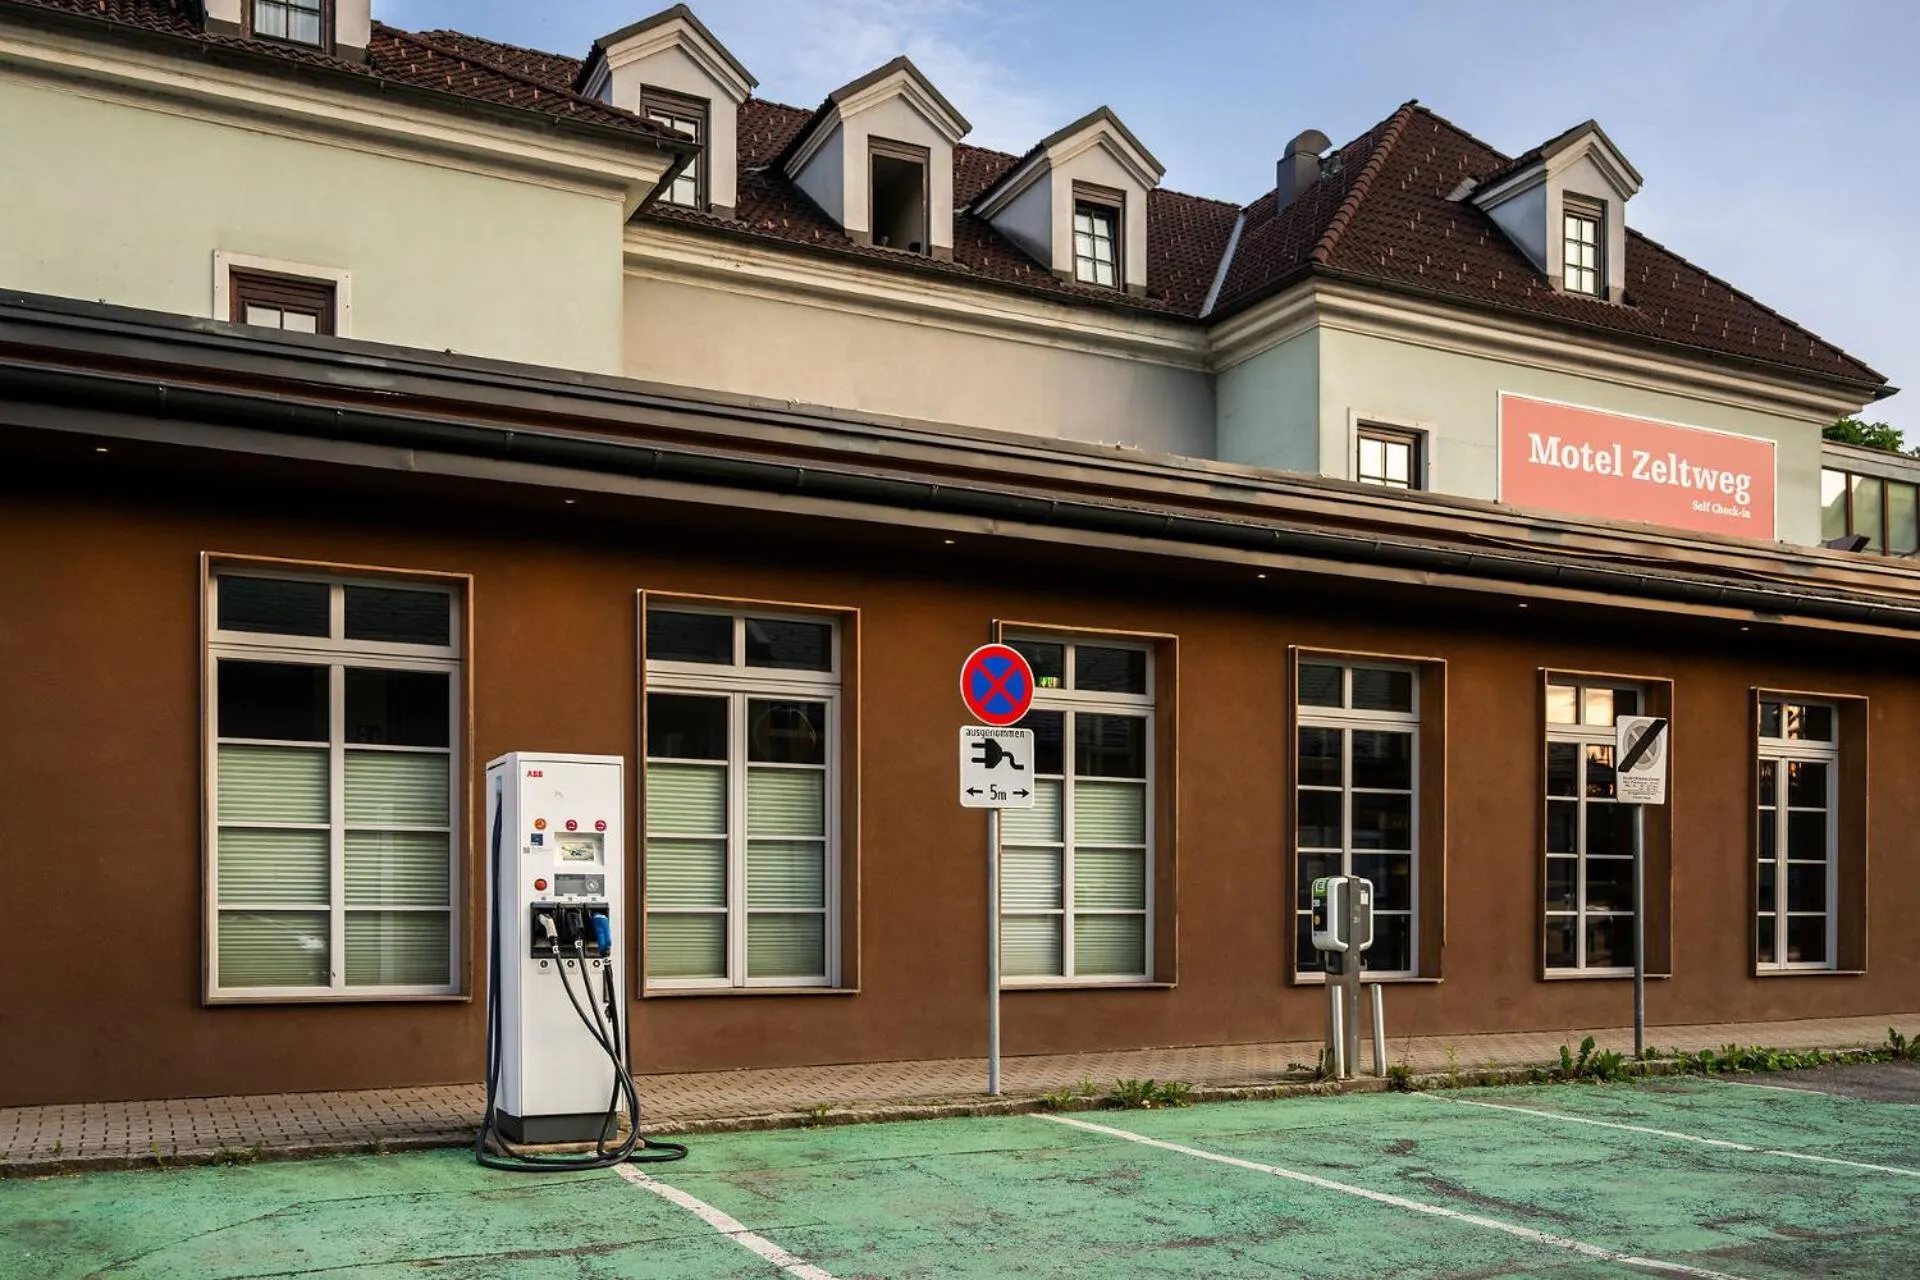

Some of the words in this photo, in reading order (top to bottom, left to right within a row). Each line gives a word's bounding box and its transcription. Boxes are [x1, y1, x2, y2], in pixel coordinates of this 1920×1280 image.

[1528, 433, 1624, 477] Motel
[1632, 450, 1751, 505] Zeltweg
[1692, 500, 1711, 512] Self
[1711, 503, 1751, 518] Check-in
[966, 728, 1025, 739] ausgenommen
[526, 770, 544, 778] ABB
[990, 784, 1007, 801] 5m
